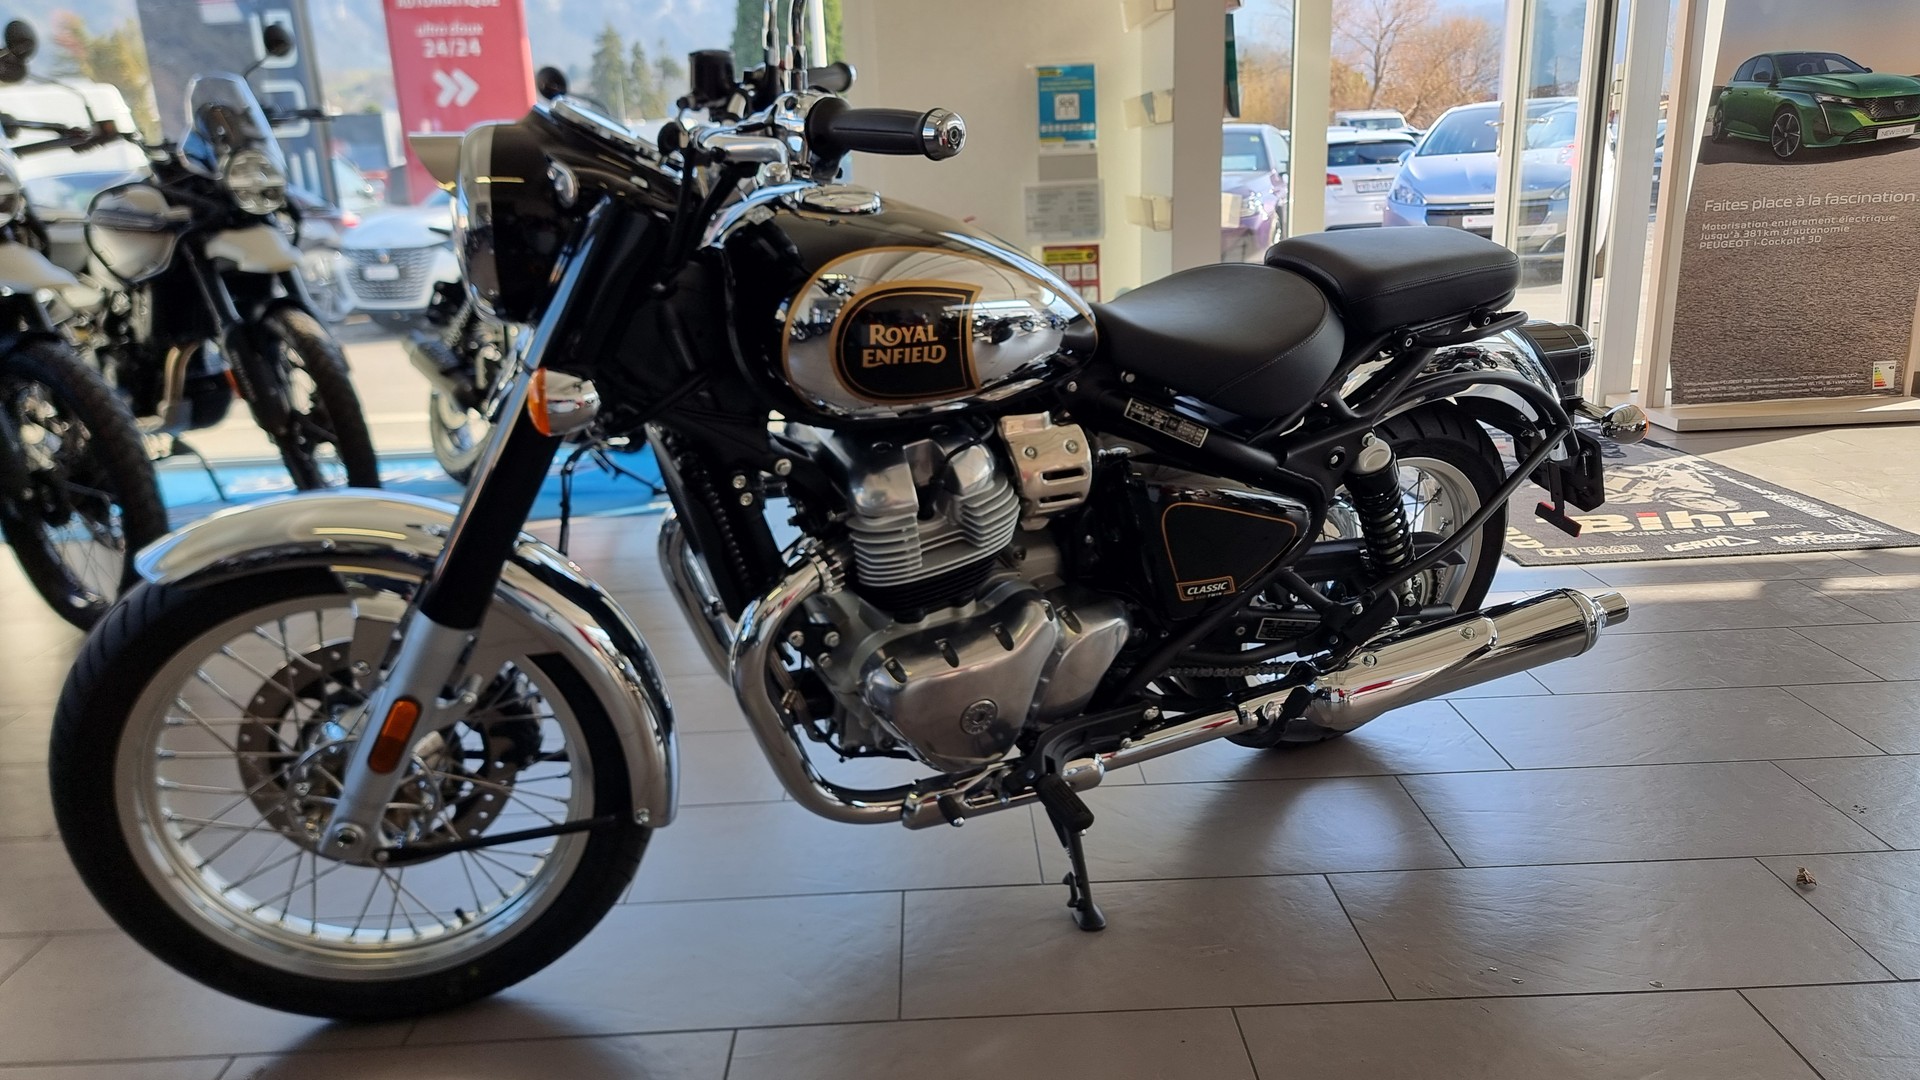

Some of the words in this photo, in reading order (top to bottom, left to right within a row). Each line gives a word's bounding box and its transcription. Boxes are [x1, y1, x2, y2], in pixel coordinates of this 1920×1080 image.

[423, 37, 481, 58] 24/24
[1704, 199, 1749, 212] Faites
[1752, 196, 1793, 211] place
[1795, 195, 1805, 207] à
[1808, 194, 1821, 206] la
[1701, 219, 1768, 231] Motorisation
[1772, 215, 1835, 228] entièrement
[1839, 213, 1896, 225] électrique
[1762, 228, 1780, 238] km
[1783, 224, 1850, 237] d'autonomie
[1699, 239, 1750, 250] PEUGEOT
[1807, 235, 1822, 244] 3D
[869, 324, 939, 347] ROYAL
[862, 345, 947, 368] ENFIELD
[1535, 510, 1771, 535] Bihr
[1612, 528, 1697, 537] Powering
[1697, 526, 1737, 534] your
[1186, 582, 1228, 596] CLASSIC
